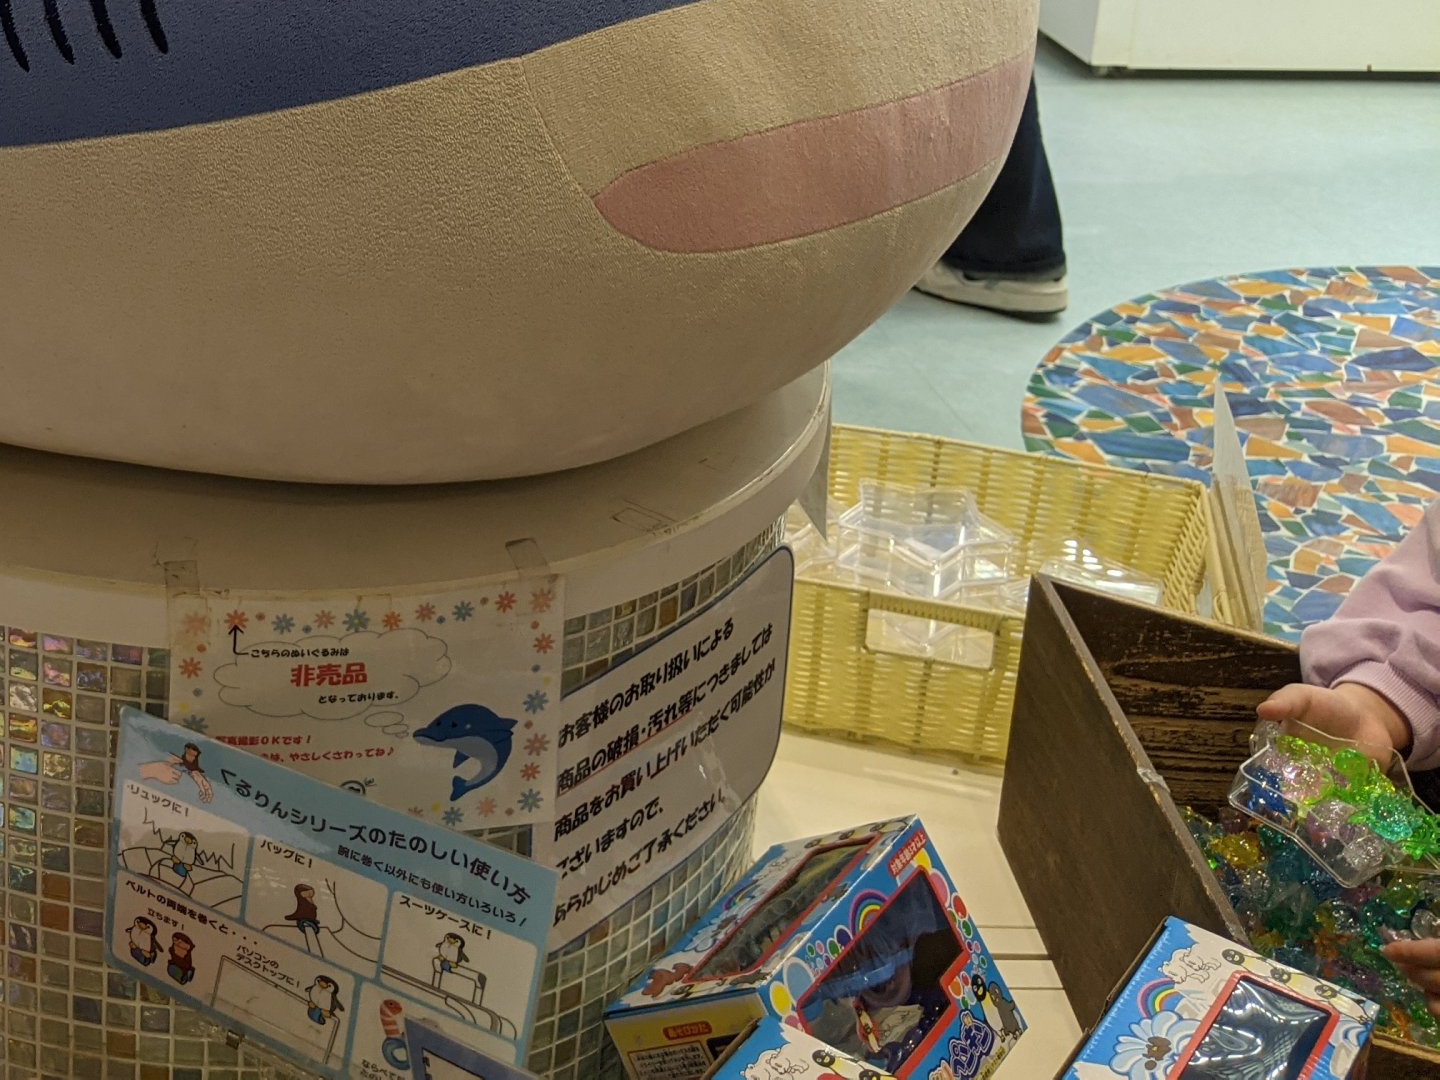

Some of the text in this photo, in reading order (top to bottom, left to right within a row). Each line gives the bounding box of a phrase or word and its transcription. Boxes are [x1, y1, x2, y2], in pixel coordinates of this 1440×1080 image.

[250, 646, 350, 659] こちらのぬいぐるみは
[290, 661, 368, 688] 非売品
[317, 691, 400, 705] となっております。
[557, 617, 736, 749] お客様のお取り扱いによる
[556, 622, 773, 793] 商品の破損・汚れ等につきましては
[554, 662, 776, 843] 商品をお買い上げいただく可能性が
[129, 785, 189, 817] リュックに！
[219, 766, 531, 905] くるりんシリーズのたのしい使い方
[259, 839, 313, 869] バッグに！
[556, 796, 665, 879] ございますので、
[338, 845, 528, 927] 腕に巻く以外にも使い方いろいろ！
[399, 896, 493, 940] スーツケースに！
[237, 945, 280, 969] パソコンの
